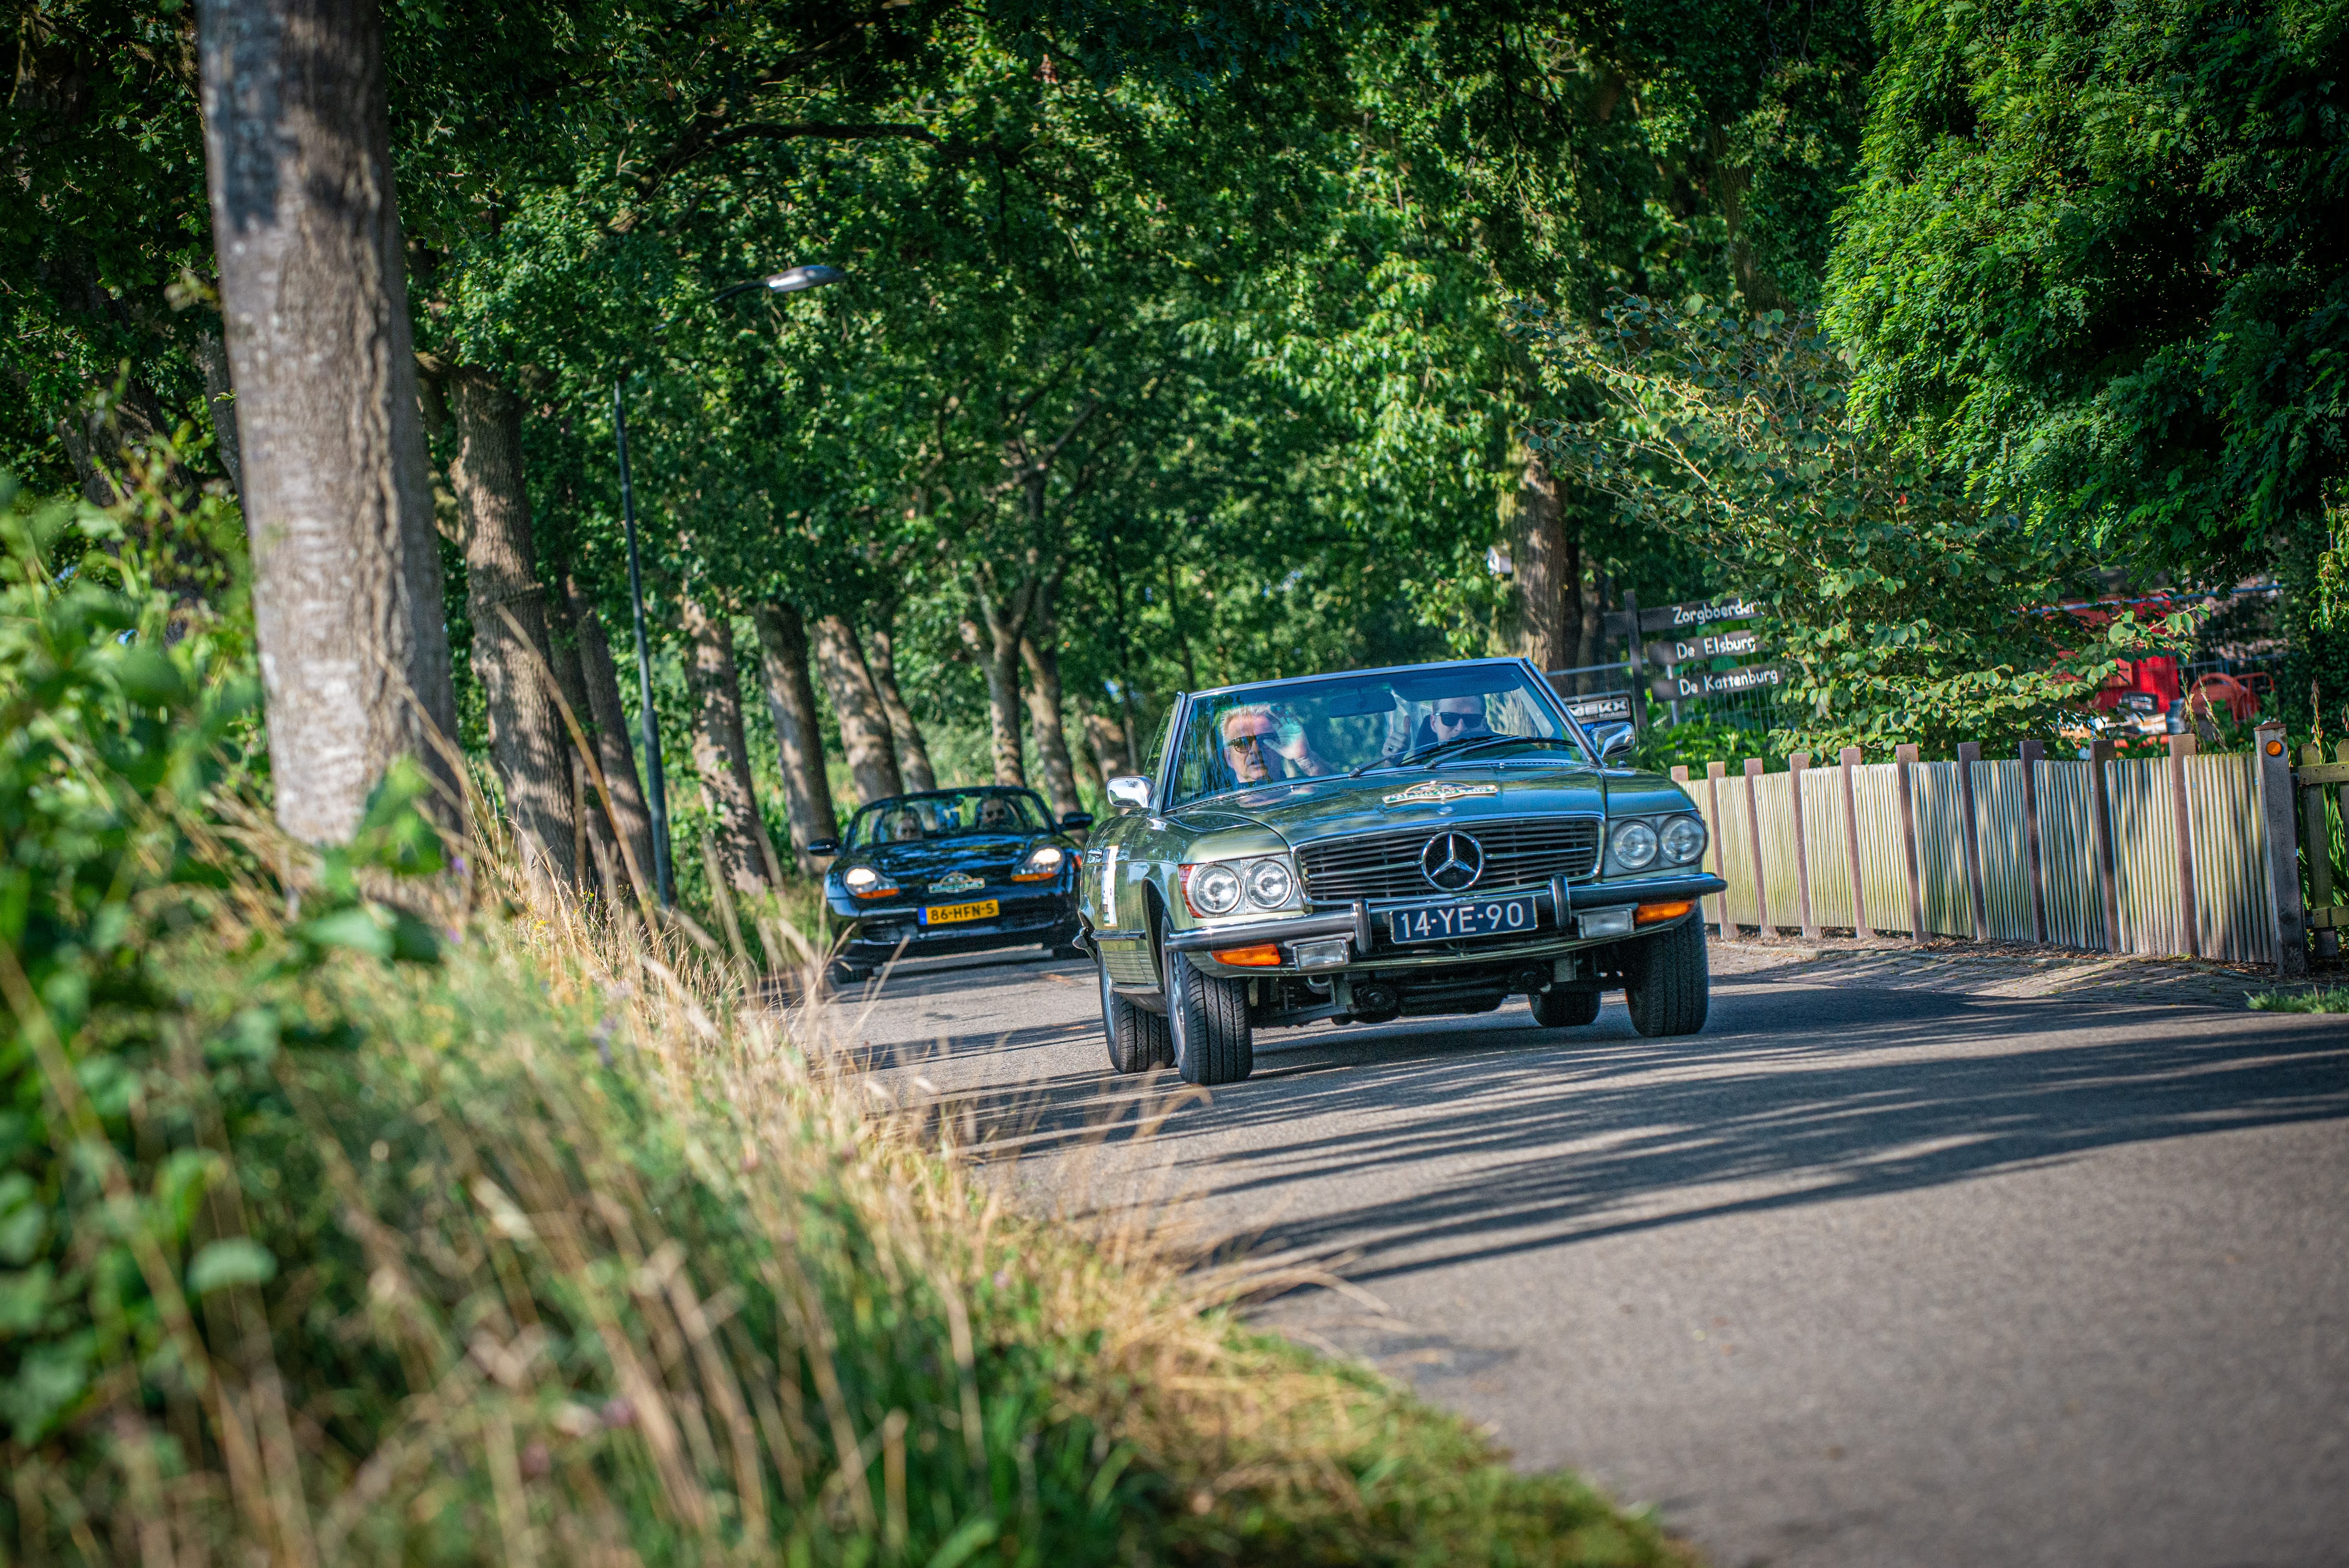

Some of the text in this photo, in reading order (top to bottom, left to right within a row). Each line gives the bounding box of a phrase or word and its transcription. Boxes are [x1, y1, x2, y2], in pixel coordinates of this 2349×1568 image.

[1672, 598, 1766, 625] Zorgboerder
[1676, 635, 1756, 660] De Elsburg
[1679, 668, 1779, 696] De Kattenburg
[930, 902, 995, 921] 86-HFN-5
[1400, 902, 1524, 938] 14-YE-90
